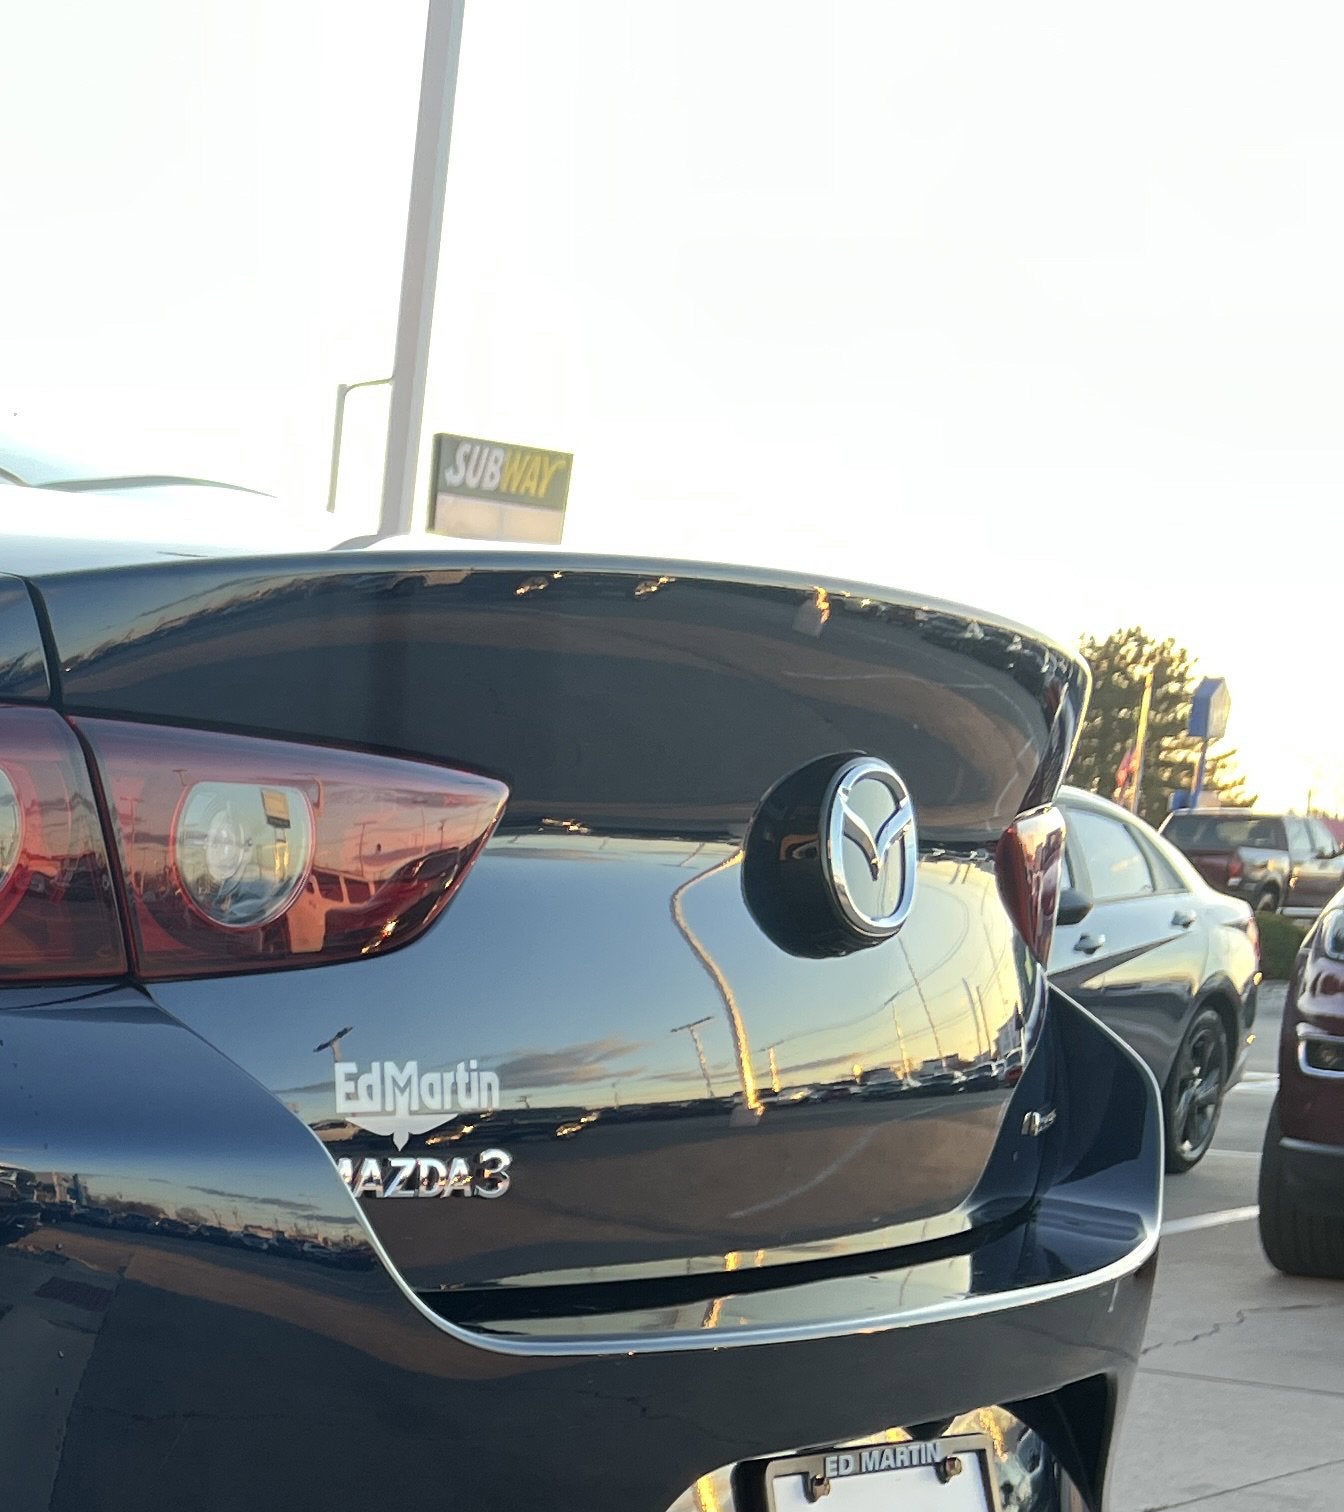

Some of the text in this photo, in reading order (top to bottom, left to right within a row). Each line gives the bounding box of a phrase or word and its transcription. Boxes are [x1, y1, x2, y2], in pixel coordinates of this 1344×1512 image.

[445, 443, 566, 498] SUBWAY
[334, 1059, 500, 1114] EdMartin
[825, 1444, 942, 1477] ED MARTIN
